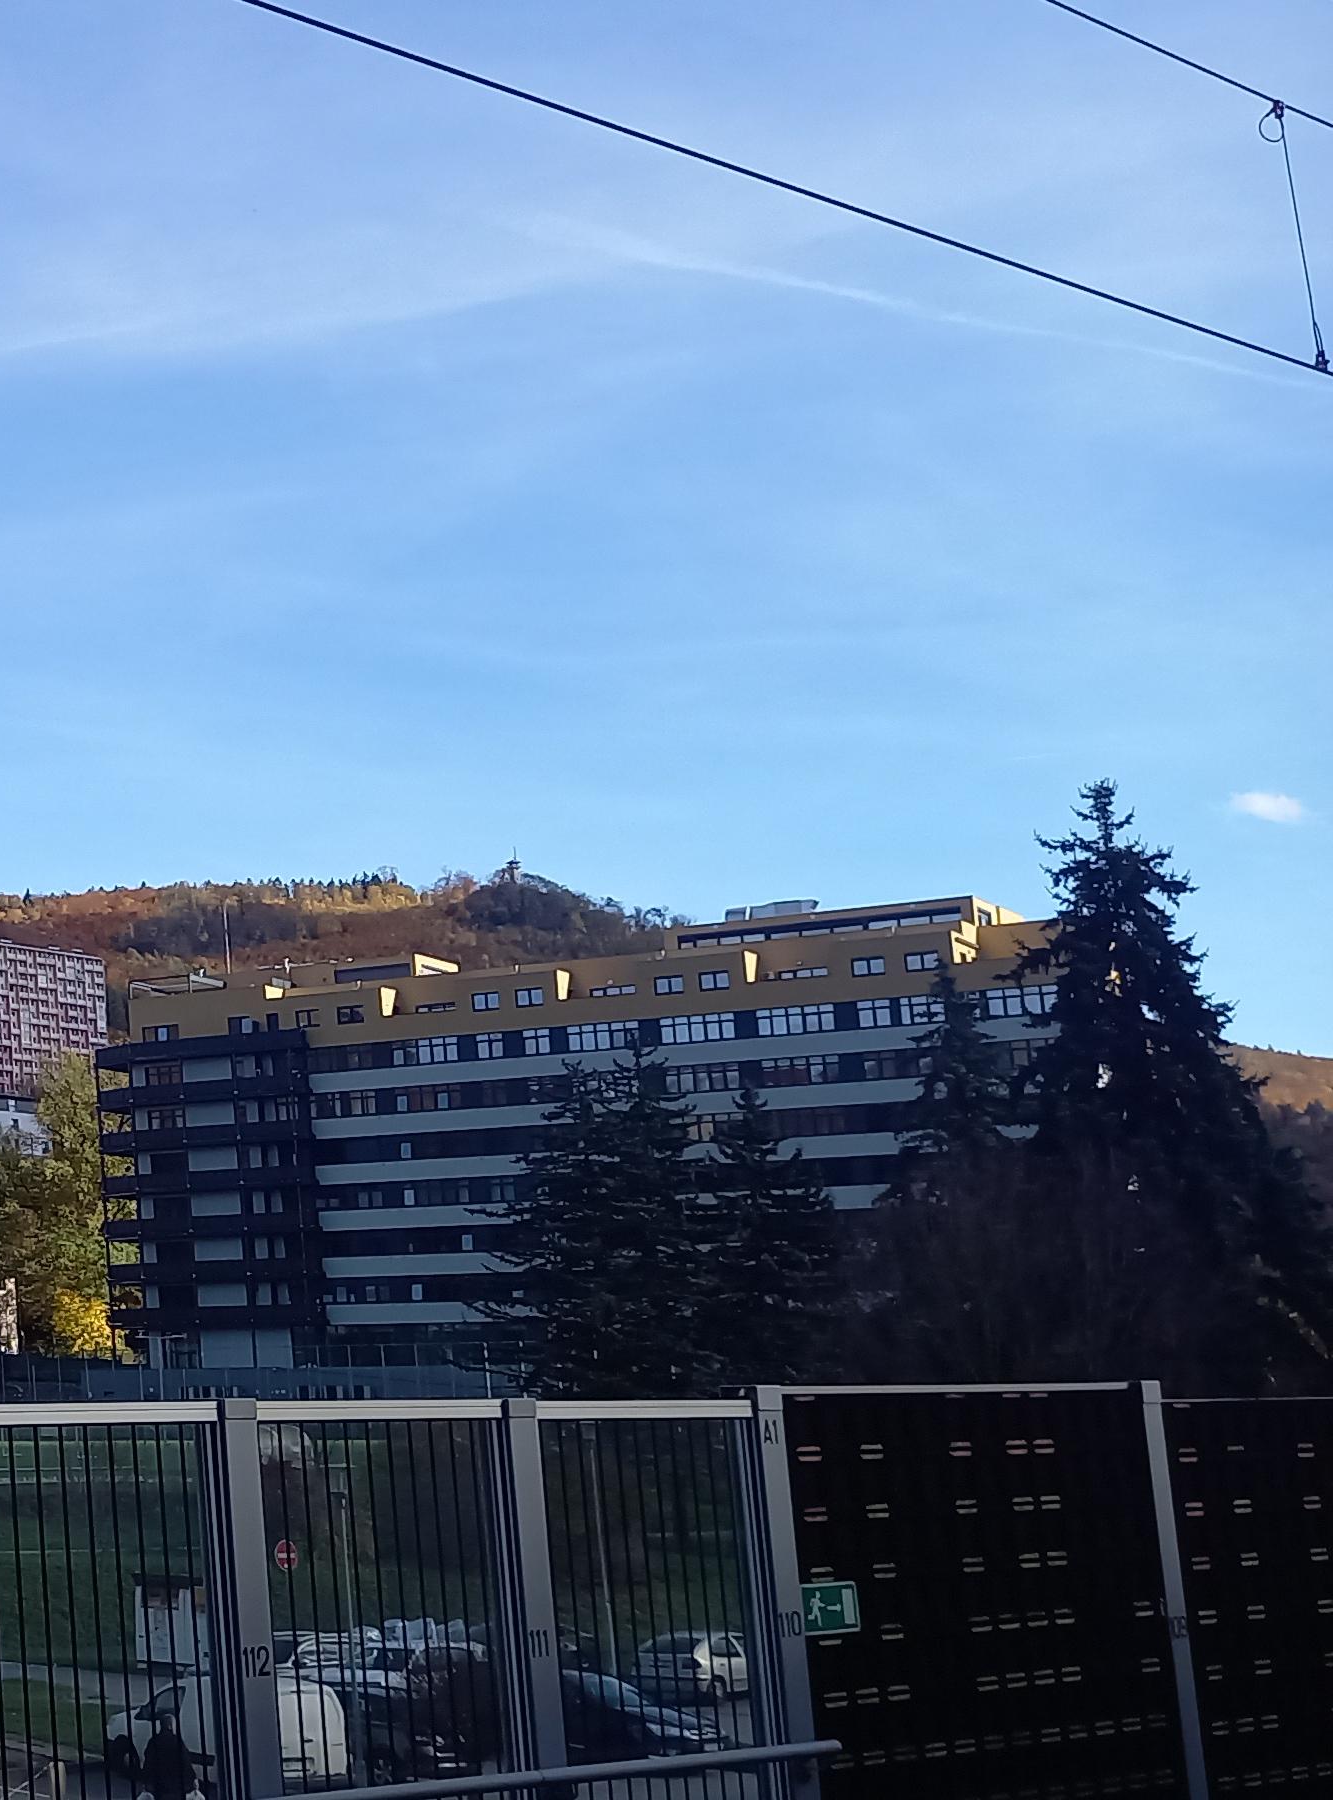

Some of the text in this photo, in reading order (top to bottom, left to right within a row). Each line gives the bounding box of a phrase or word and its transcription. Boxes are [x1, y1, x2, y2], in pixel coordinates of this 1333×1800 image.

[763, 1419, 779, 1445] A1
[778, 1610, 802, 1638] 110
[529, 1629, 550, 1658] 111
[242, 1645, 271, 1678] 112
